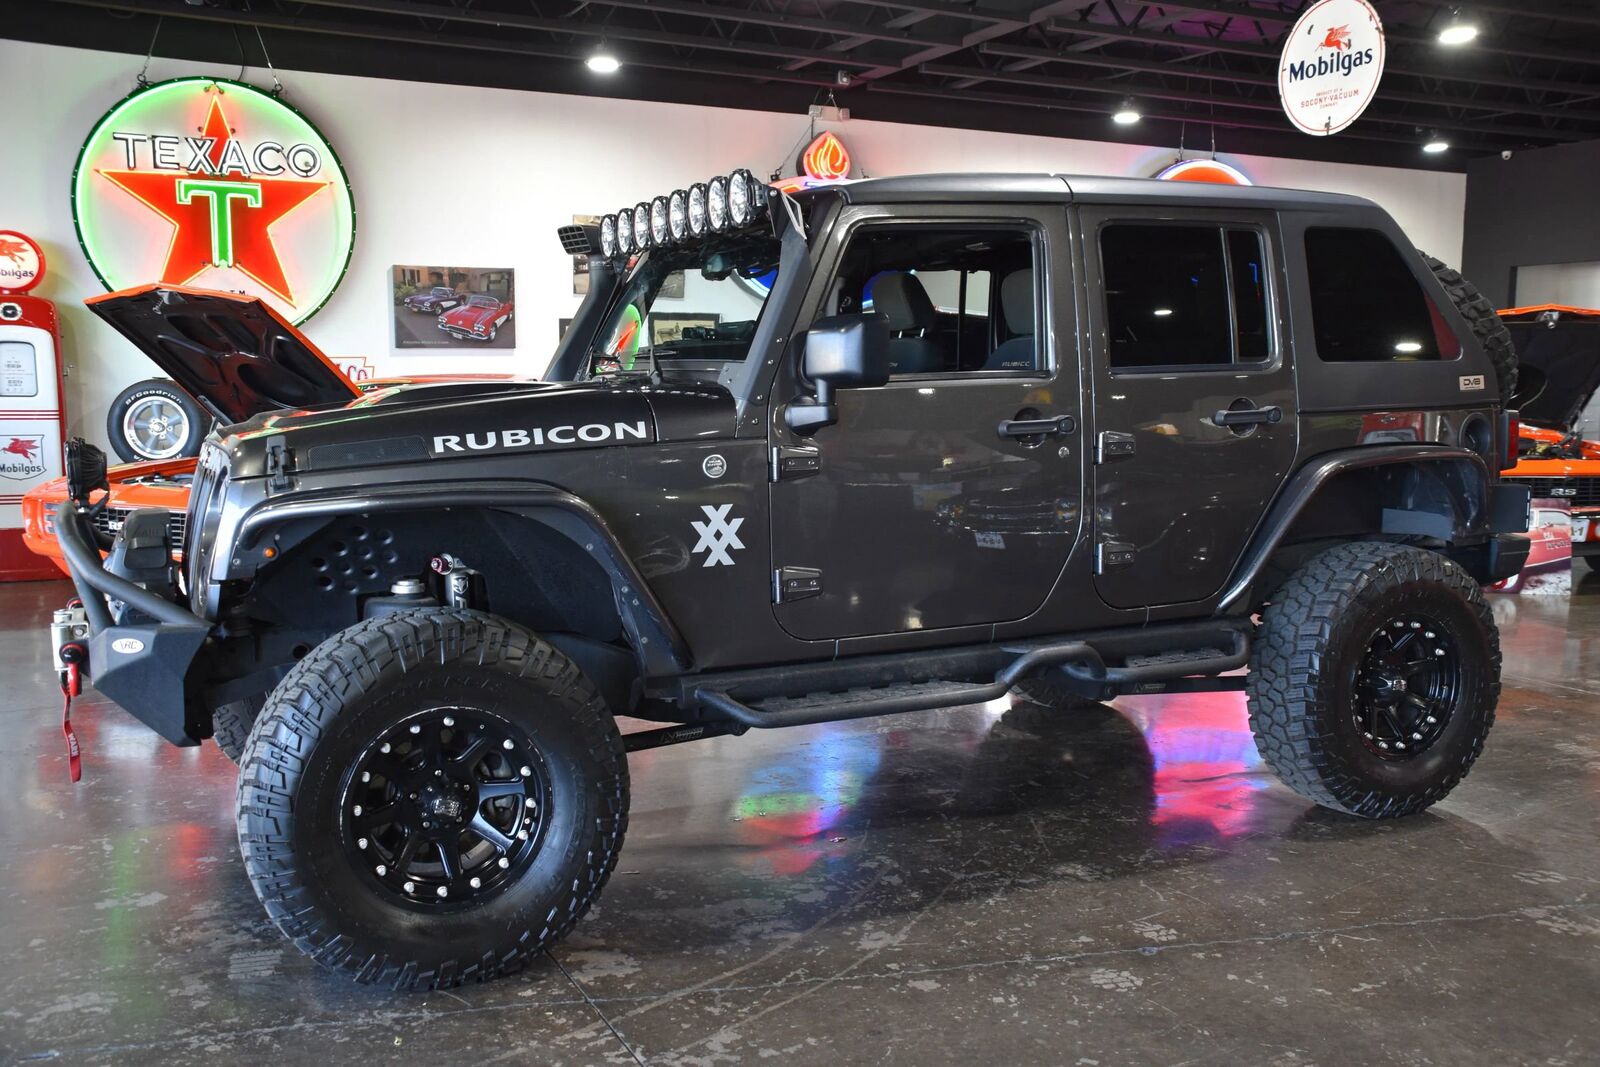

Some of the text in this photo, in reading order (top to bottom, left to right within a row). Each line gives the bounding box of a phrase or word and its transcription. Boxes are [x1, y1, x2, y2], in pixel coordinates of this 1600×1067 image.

[1289, 48, 1373, 83] Mobilgas
[112, 132, 322, 177] TEXACO
[175, 179, 262, 267] T
[0, 268, 34, 280] bilgas
[433, 421, 647, 453] RUBICON
[1550, 488, 1577, 496] RS
